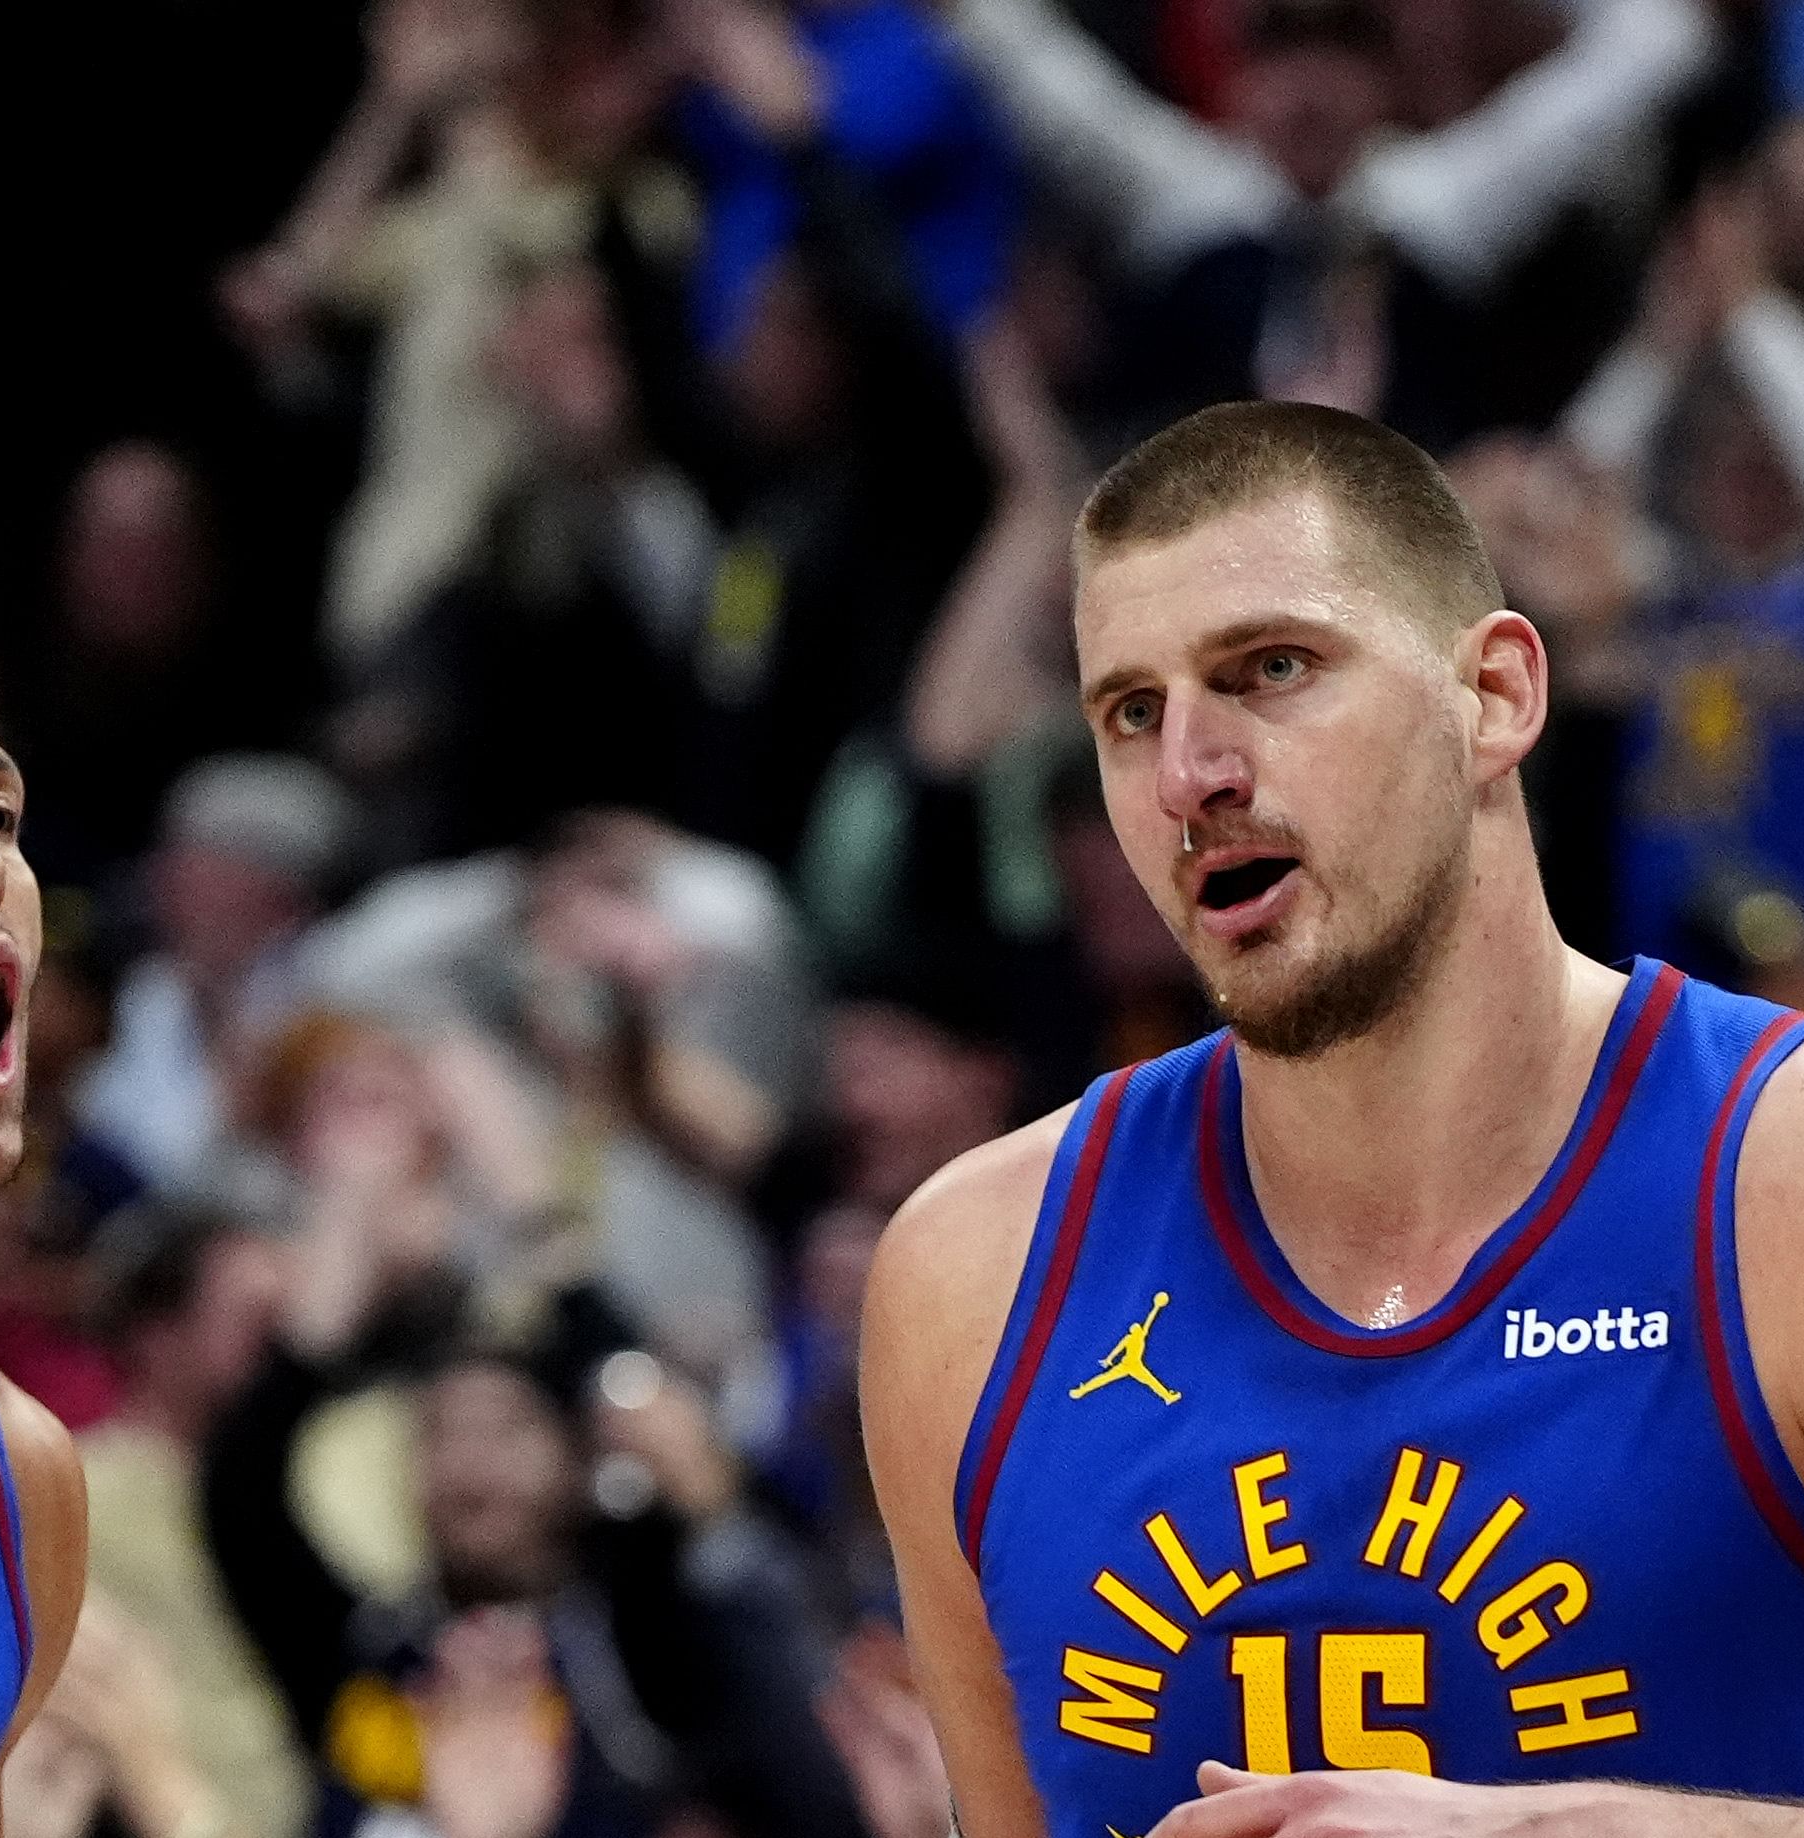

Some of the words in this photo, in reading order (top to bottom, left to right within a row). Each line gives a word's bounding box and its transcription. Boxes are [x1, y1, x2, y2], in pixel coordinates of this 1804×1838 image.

[1503, 1307, 1671, 1359] ibotta
[1059, 1449, 1308, 1756] MILE
[1362, 1446, 1641, 1754] HIGH
[1229, 1632, 1434, 1778] 15
